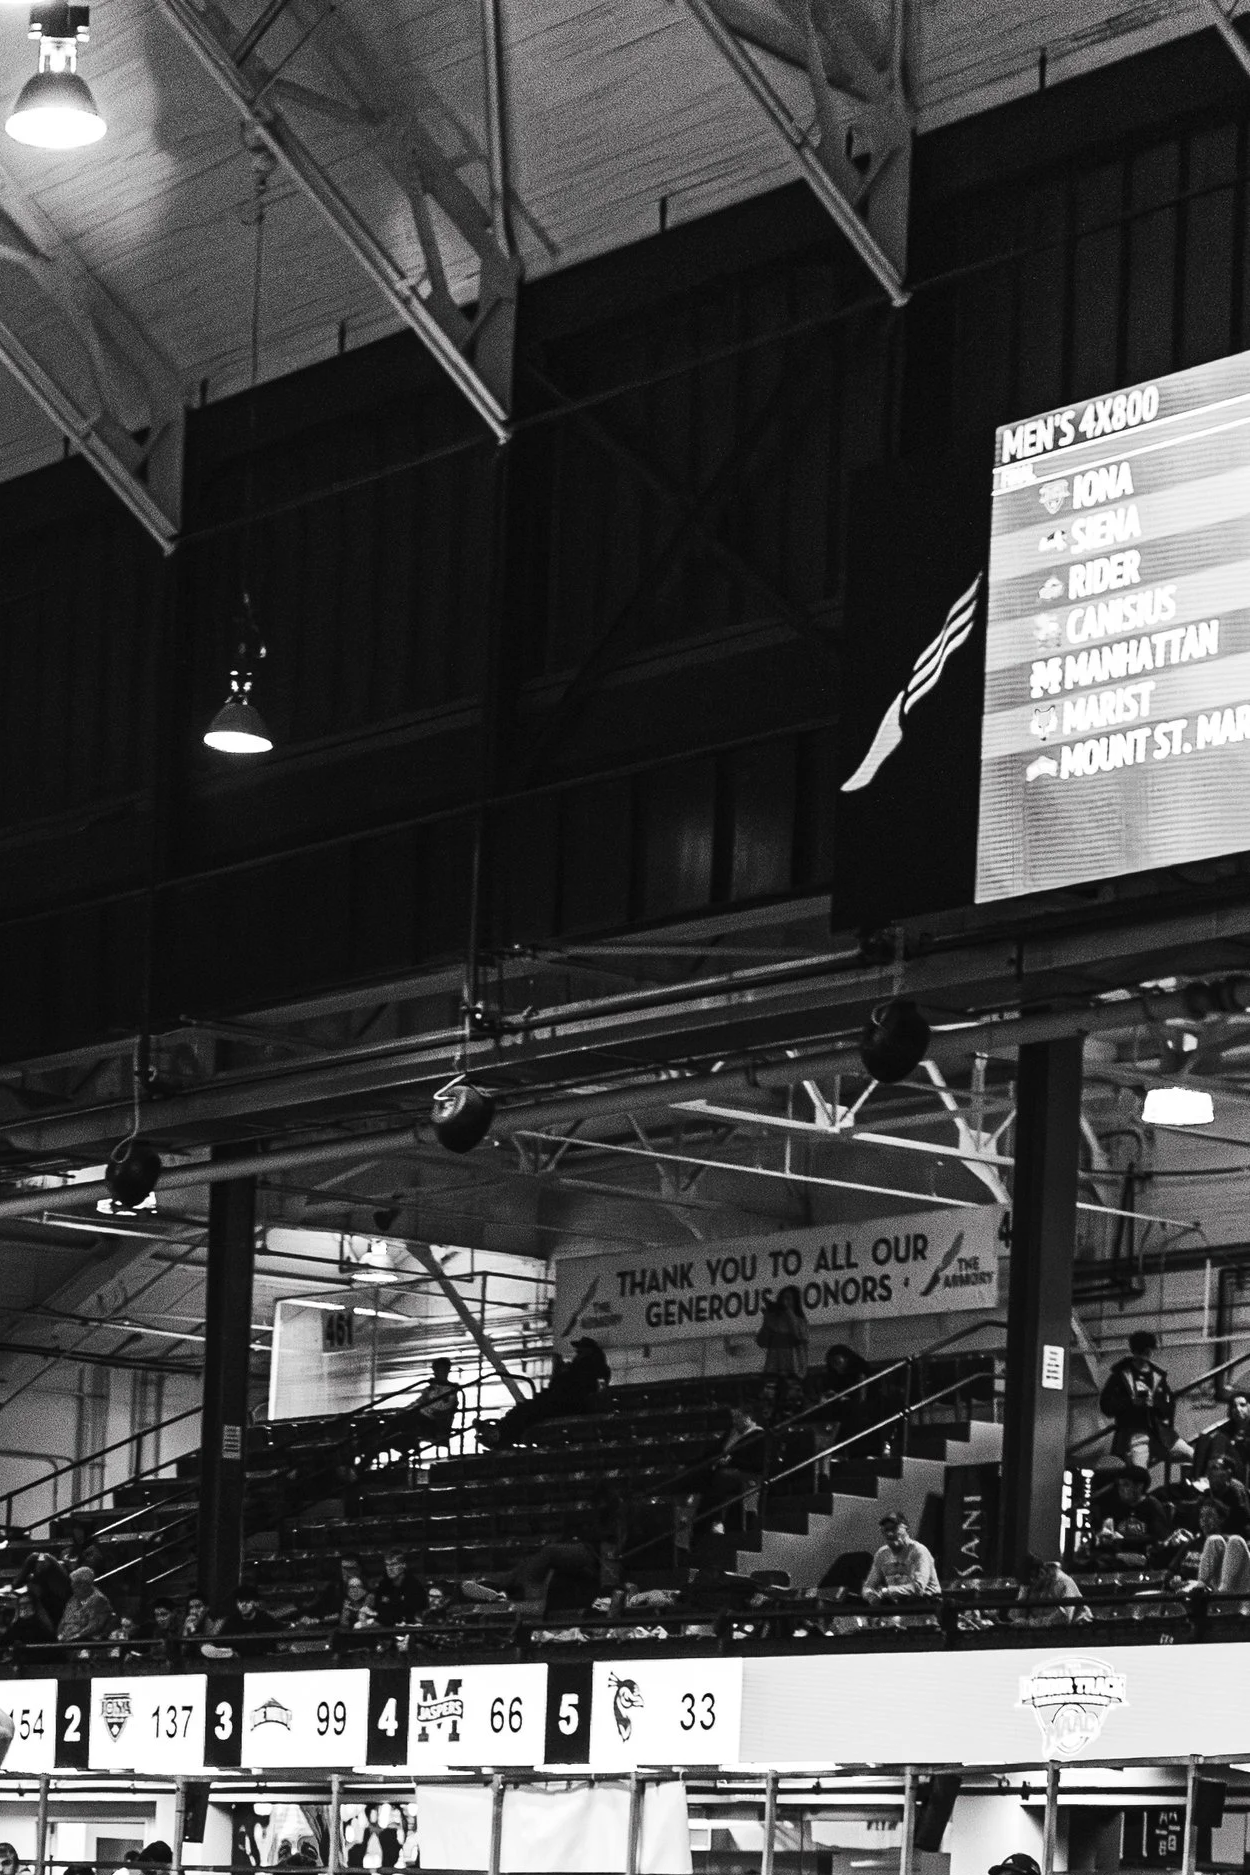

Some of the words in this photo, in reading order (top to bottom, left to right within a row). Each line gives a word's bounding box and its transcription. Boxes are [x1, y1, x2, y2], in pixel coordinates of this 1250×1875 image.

[1001, 409, 1076, 463] MEN'S
[1078, 385, 1159, 439] 4X800
[1072, 462, 1134, 509] IONA
[1070, 504, 1141, 554] SIENA
[1068, 549, 1141, 600] RIDER
[1066, 584, 1177, 644] CANISIUS
[1064, 619, 1219, 690] MANHATTAN
[1062, 680, 1156, 735] MARIST
[1060, 727, 1152, 780] MOUNT
[1153, 719, 1193, 760] ST.
[617, 1262, 694, 1298] THANK
[706, 1252, 757, 1286] YOU
[769, 1248, 802, 1279] TO
[814, 1241, 859, 1273] ALL
[871, 1233, 929, 1266] OUR
[645, 1287, 775, 1328] GENEROUS
[803, 1273, 893, 1310] ONORS
[63, 1705, 82, 1742] 2
[152, 1705, 193, 1739] 137
[214, 1701, 233, 1740] 3
[317, 1701, 347, 1736] 99
[377, 1697, 398, 1737] 4
[490, 1697, 523, 1733] 66
[558, 1693, 579, 1735] 5
[680, 1693, 716, 1731] 33
